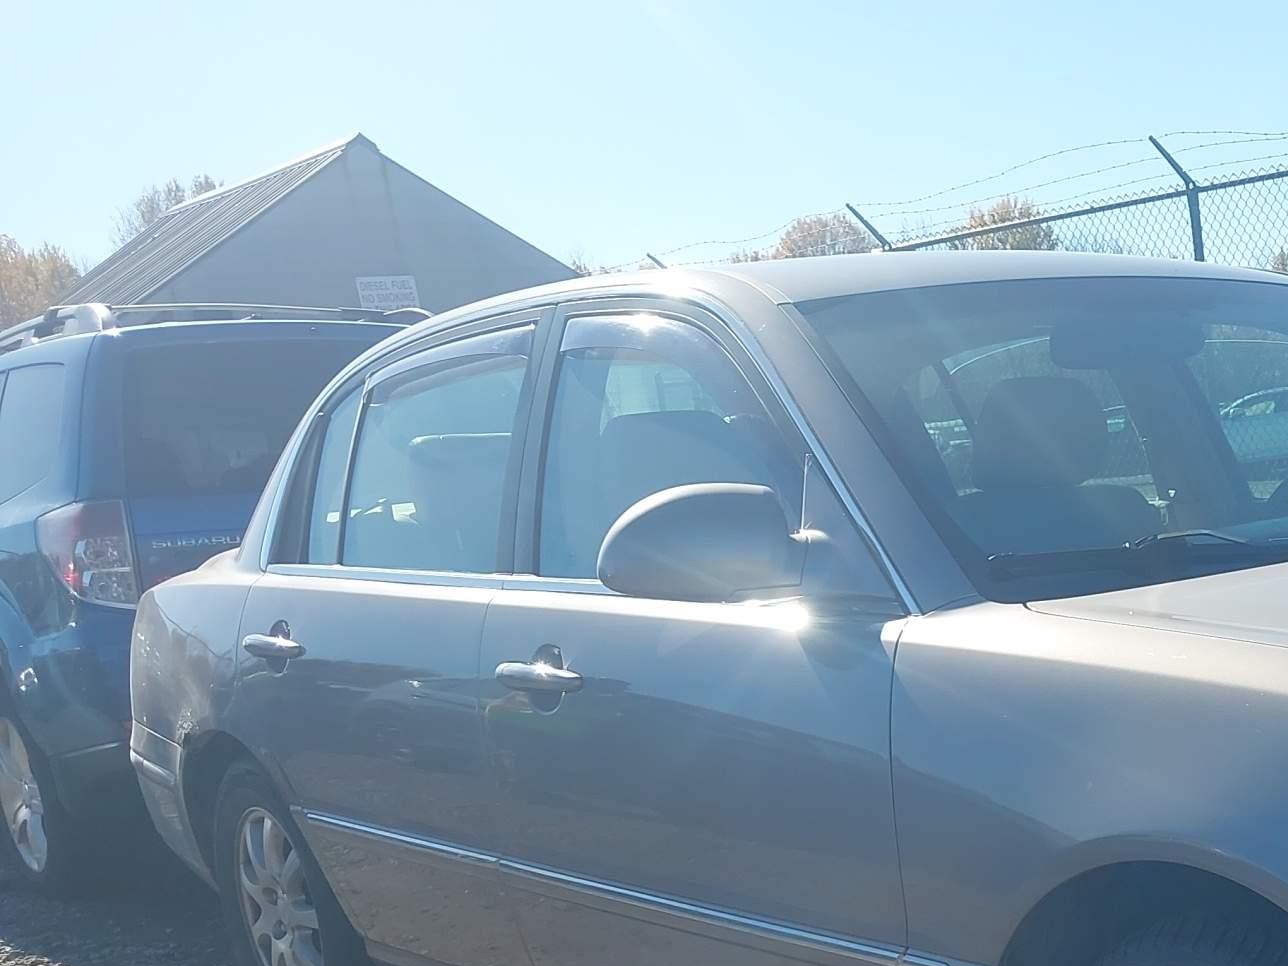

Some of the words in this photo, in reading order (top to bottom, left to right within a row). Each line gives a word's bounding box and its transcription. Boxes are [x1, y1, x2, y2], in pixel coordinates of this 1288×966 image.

[359, 280, 389, 291] DIESEL
[391, 279, 413, 290] FUEL
[361, 293, 376, 304] NO
[376, 292, 416, 303] SMOKING
[151, 535, 241, 549] SUBARU
